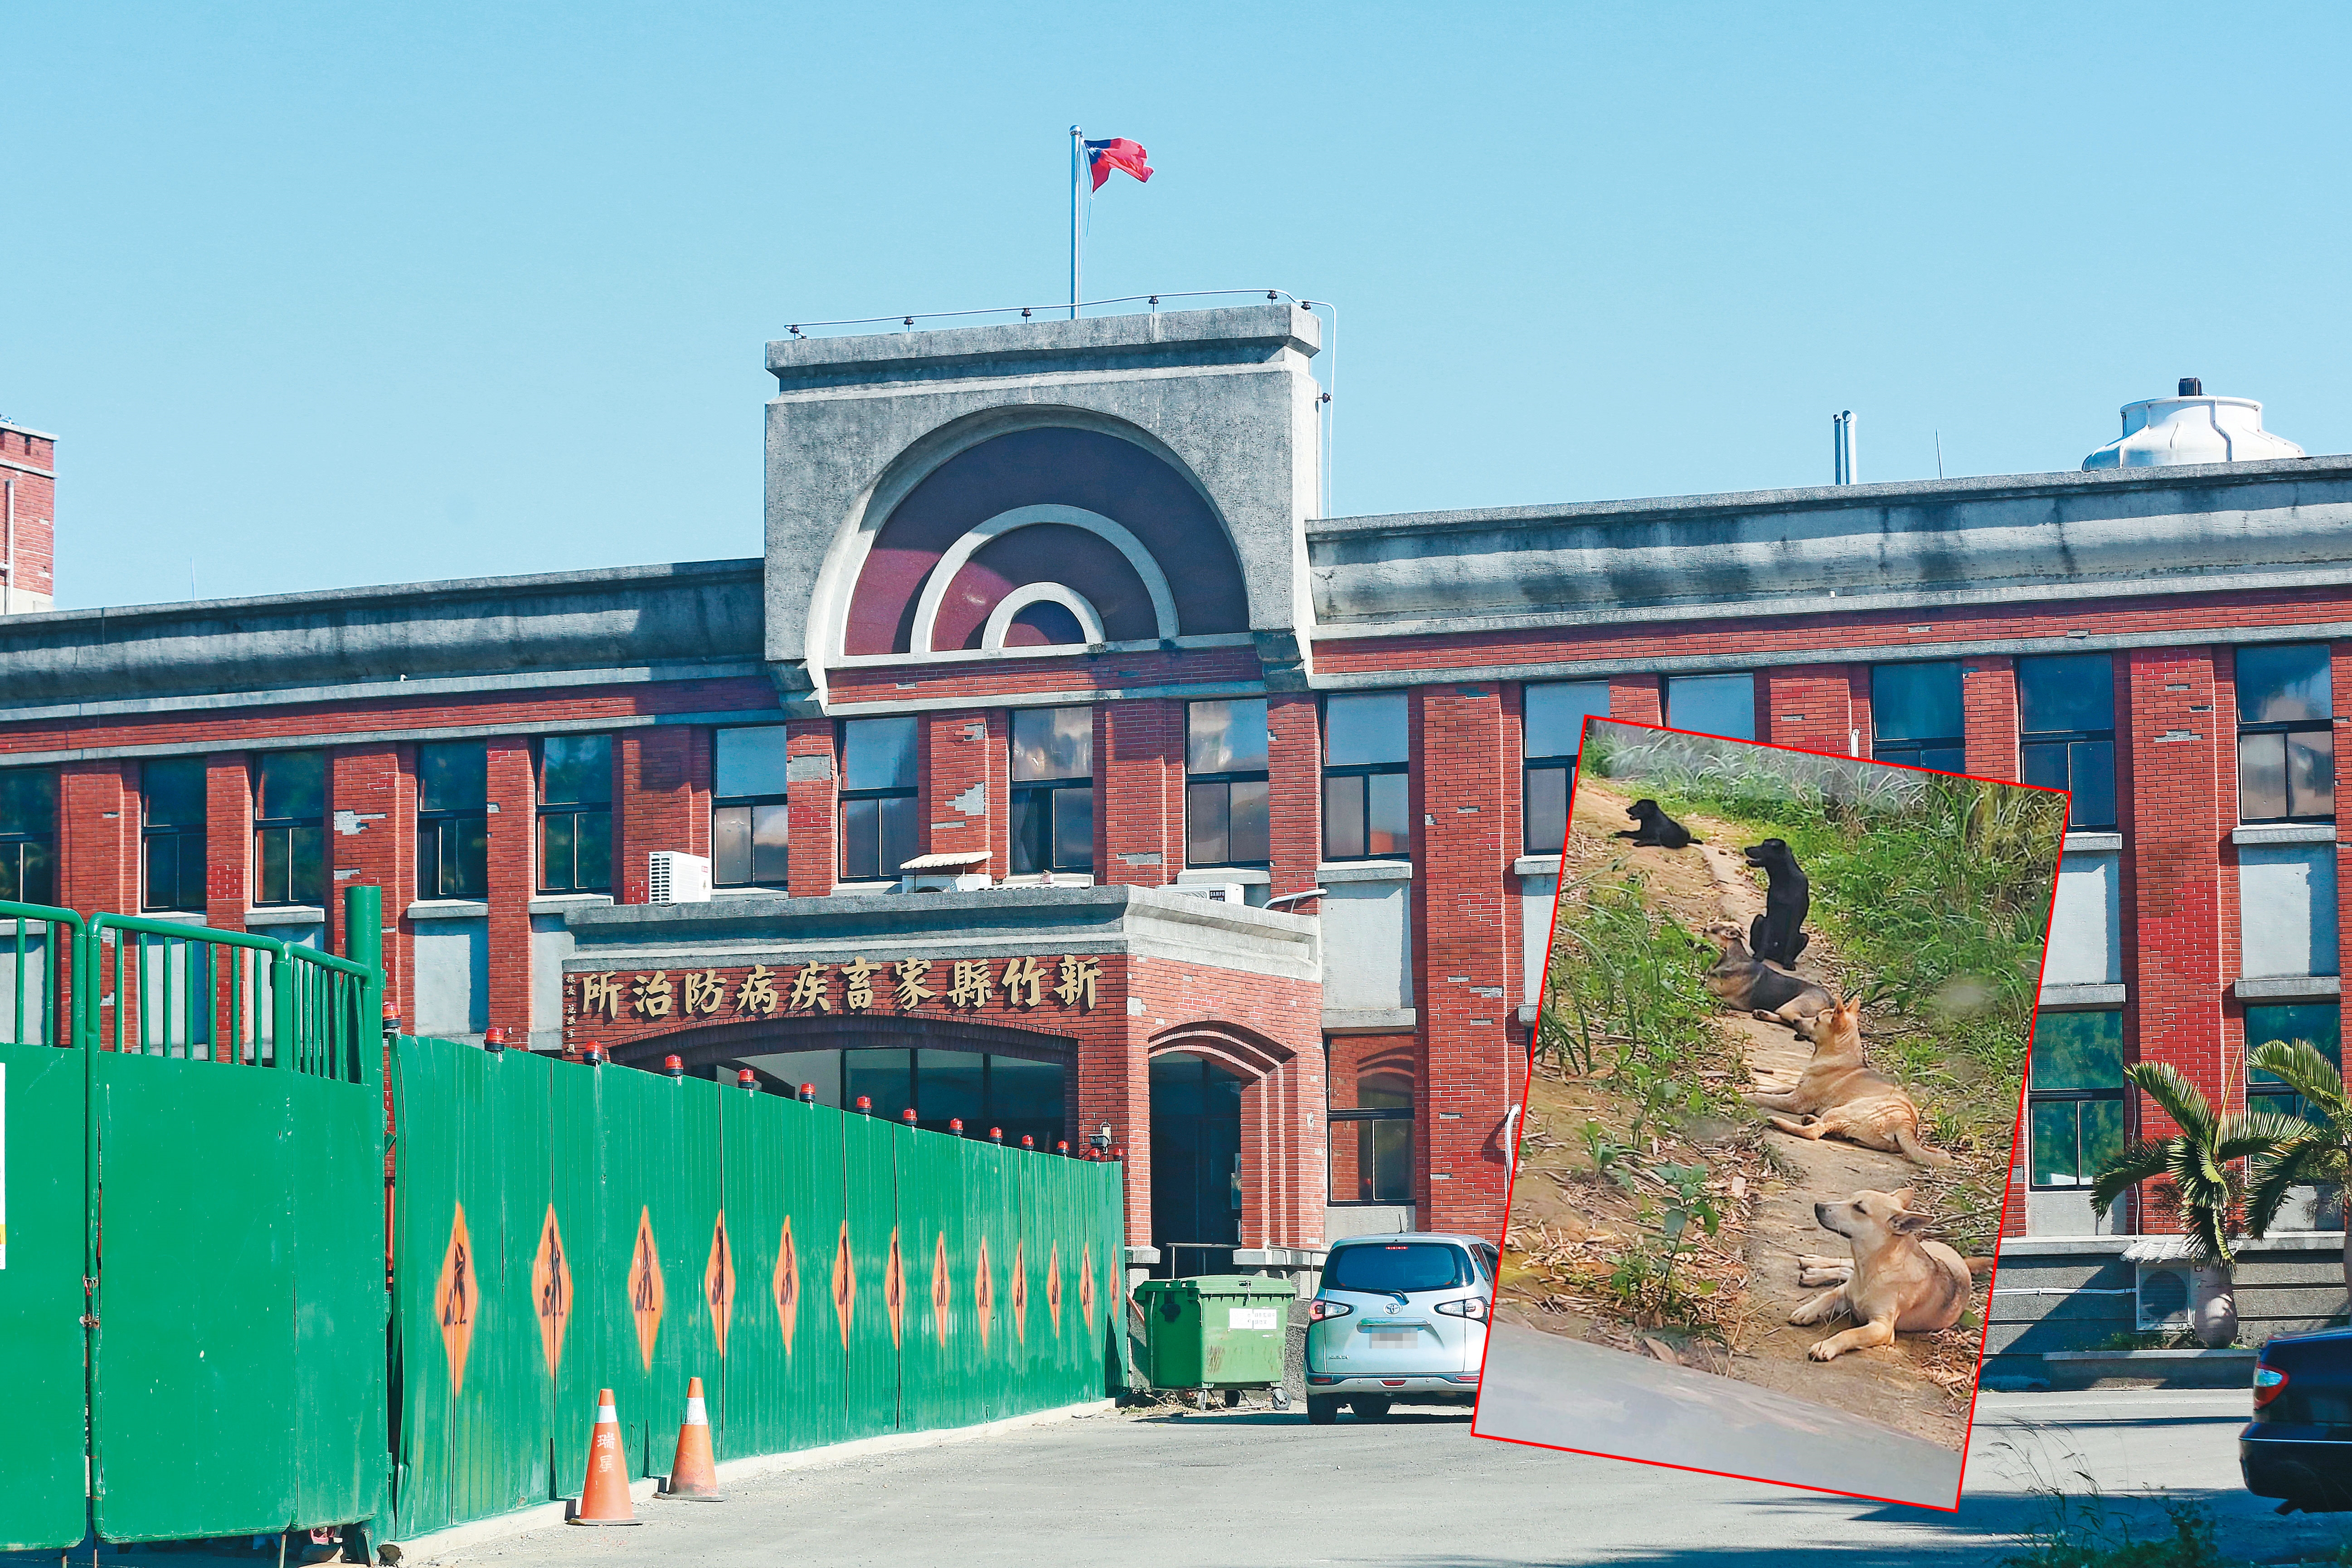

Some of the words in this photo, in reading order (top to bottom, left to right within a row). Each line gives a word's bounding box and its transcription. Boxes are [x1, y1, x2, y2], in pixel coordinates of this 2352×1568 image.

[583, 954, 1103, 1019] 新竹縣家畜疾病防治所
